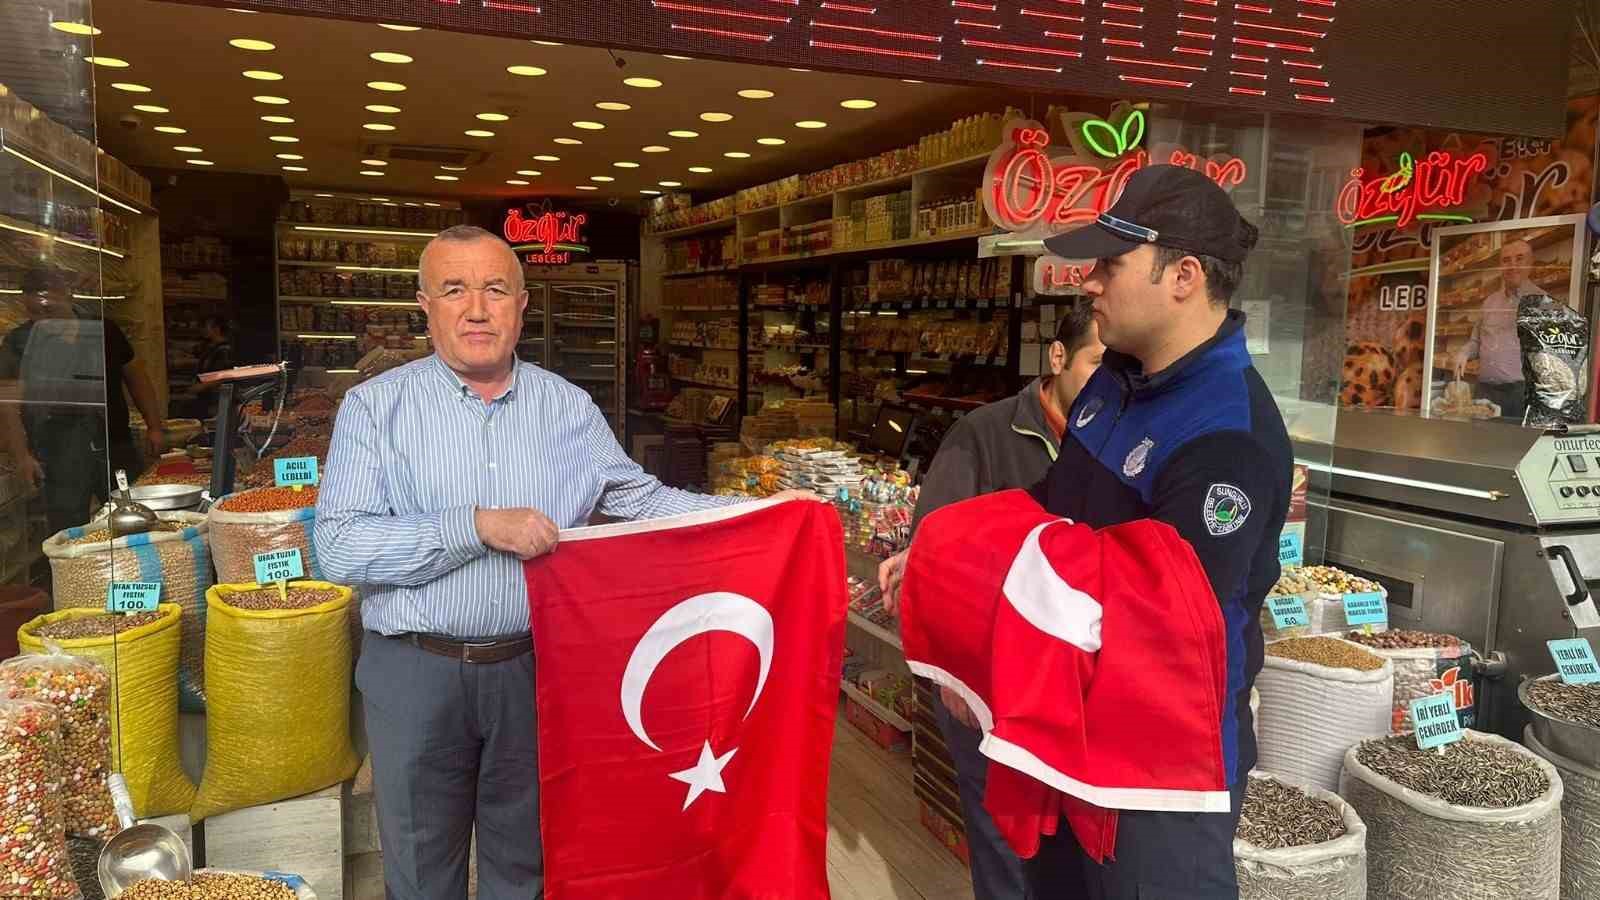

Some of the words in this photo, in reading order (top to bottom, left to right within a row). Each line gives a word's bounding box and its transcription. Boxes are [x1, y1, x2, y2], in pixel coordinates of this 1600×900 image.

[1336, 151, 1488, 228] Özgür
[504, 209, 586, 254] Özgür
[1418, 719, 1457, 740] ÇEKİRDEK
